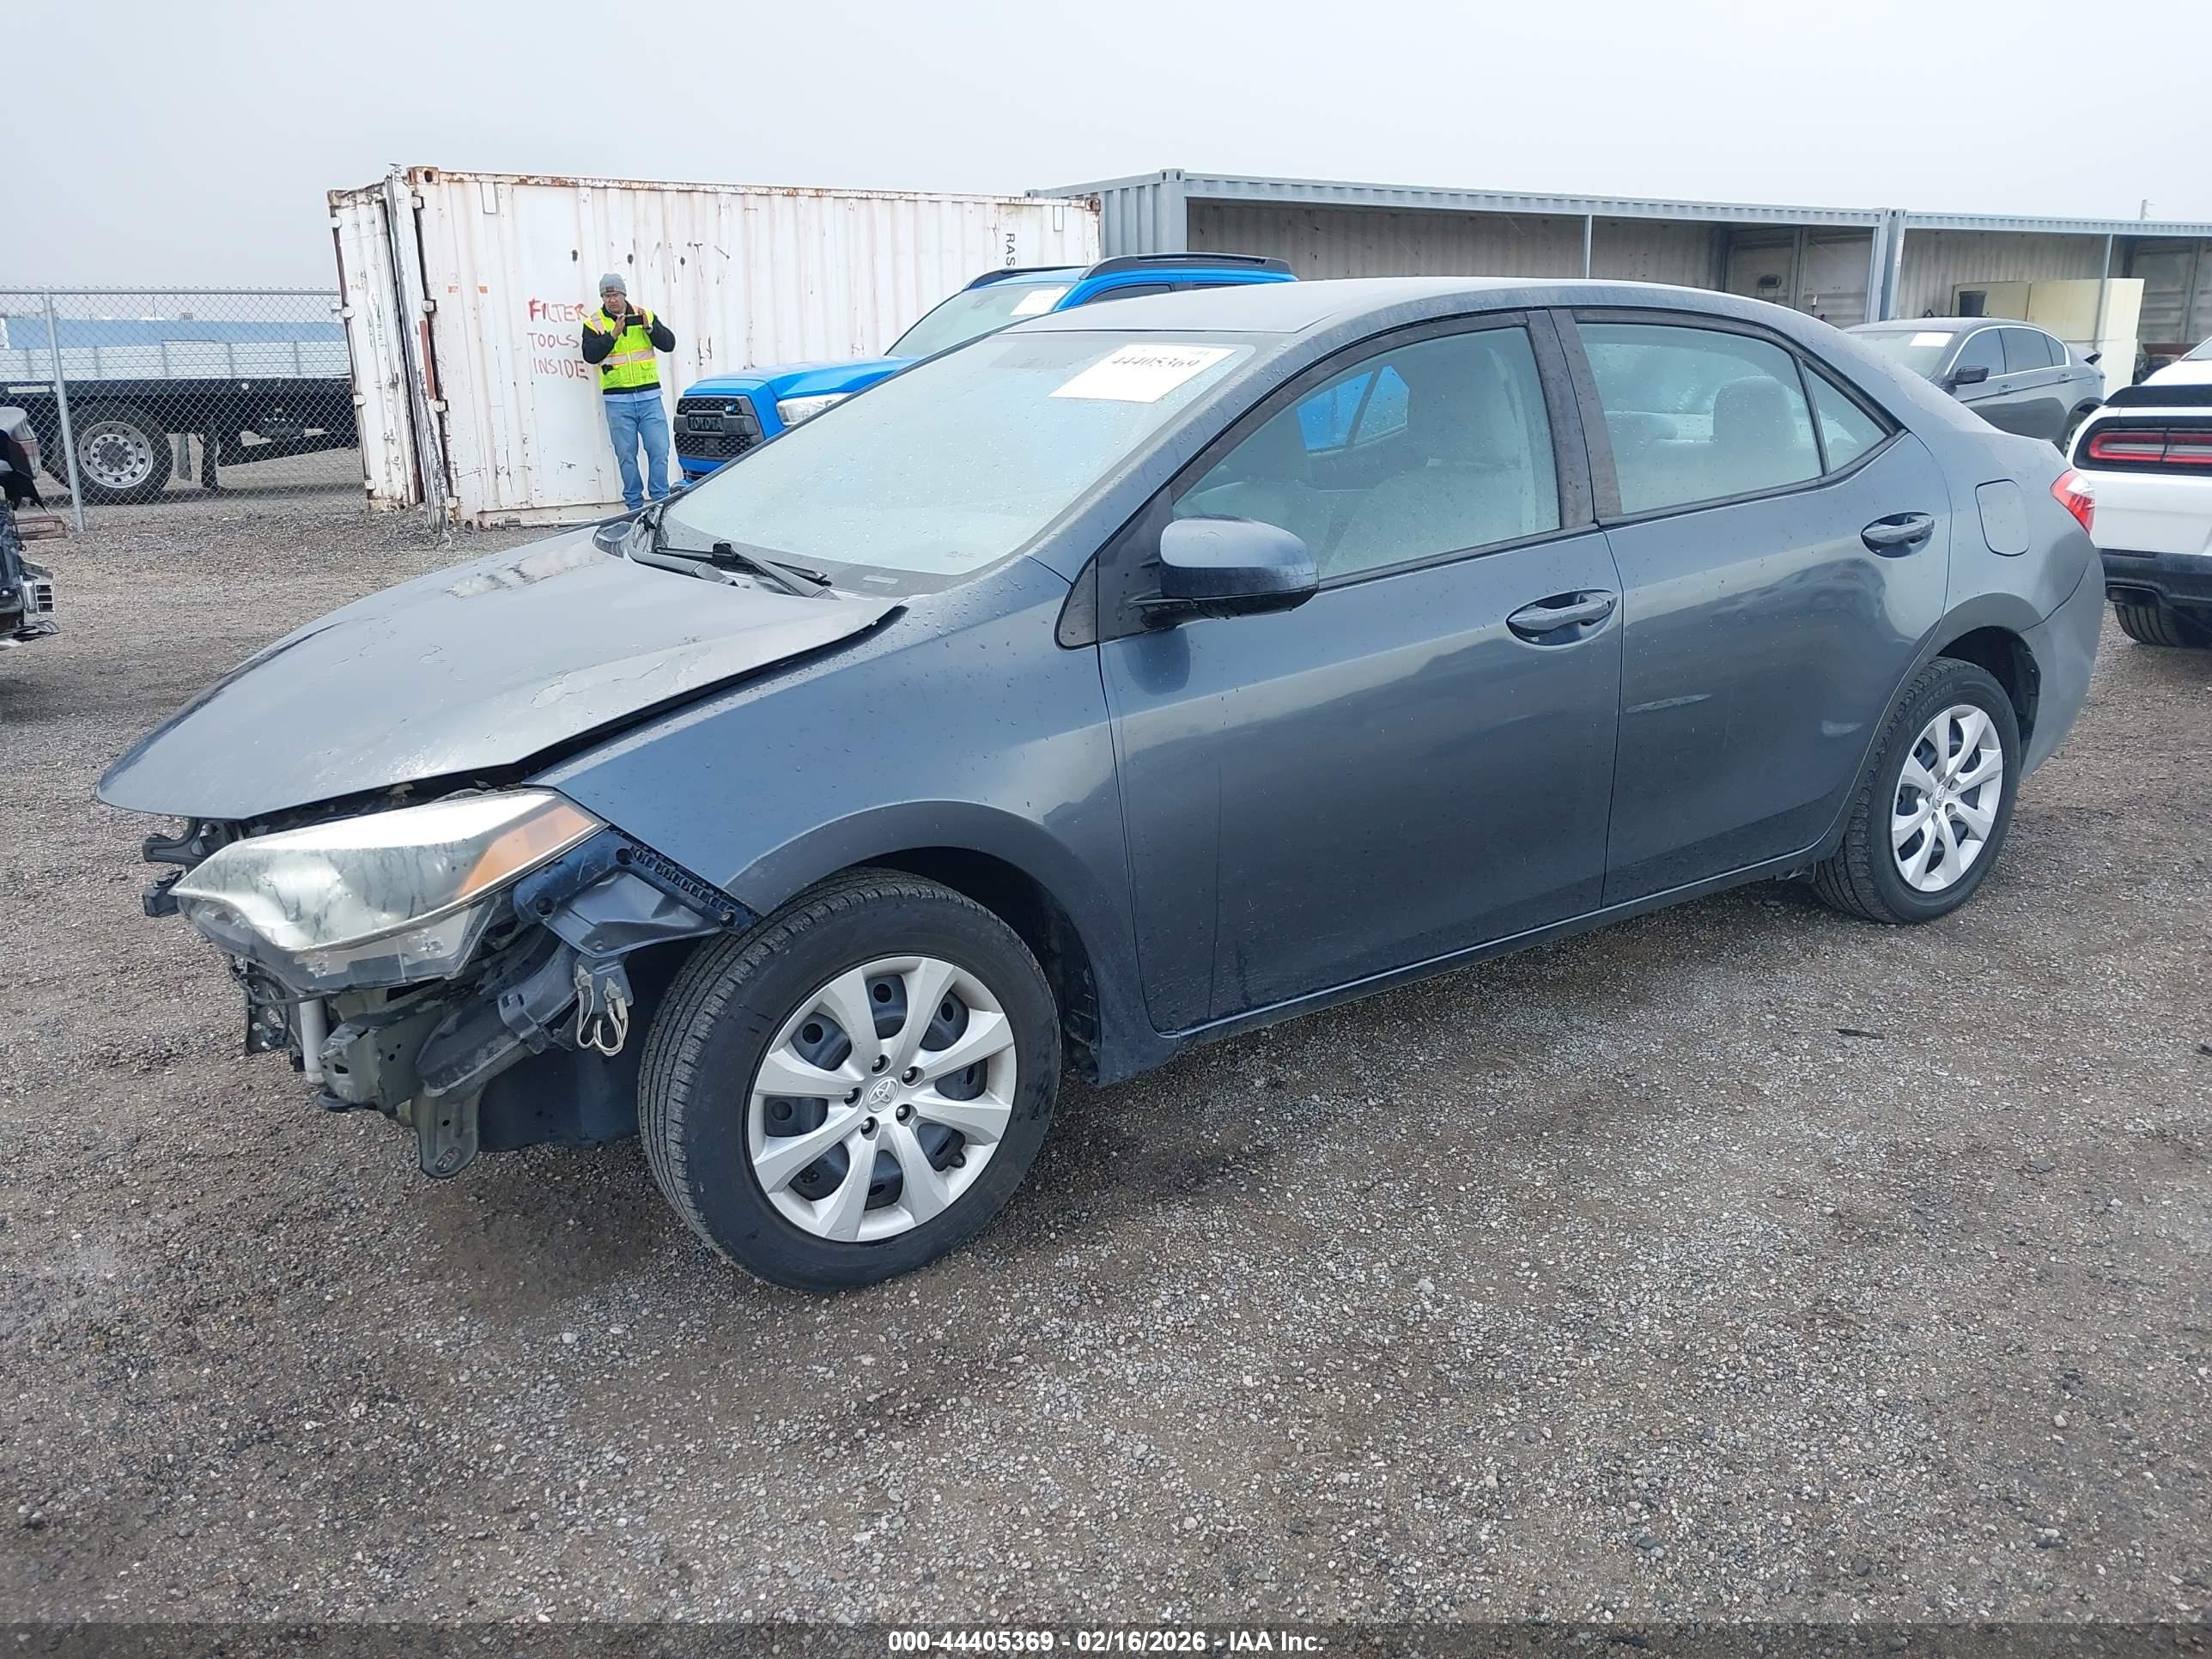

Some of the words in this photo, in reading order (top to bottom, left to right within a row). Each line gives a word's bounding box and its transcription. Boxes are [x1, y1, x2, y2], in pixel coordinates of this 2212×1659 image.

[528, 298, 589, 323] FILTER
[526, 332, 580, 351] TOOLS
[533, 357, 589, 380] INSIDE
[1112, 356, 1200, 368] 44405369
[690, 416, 724, 431] TOYOTA
